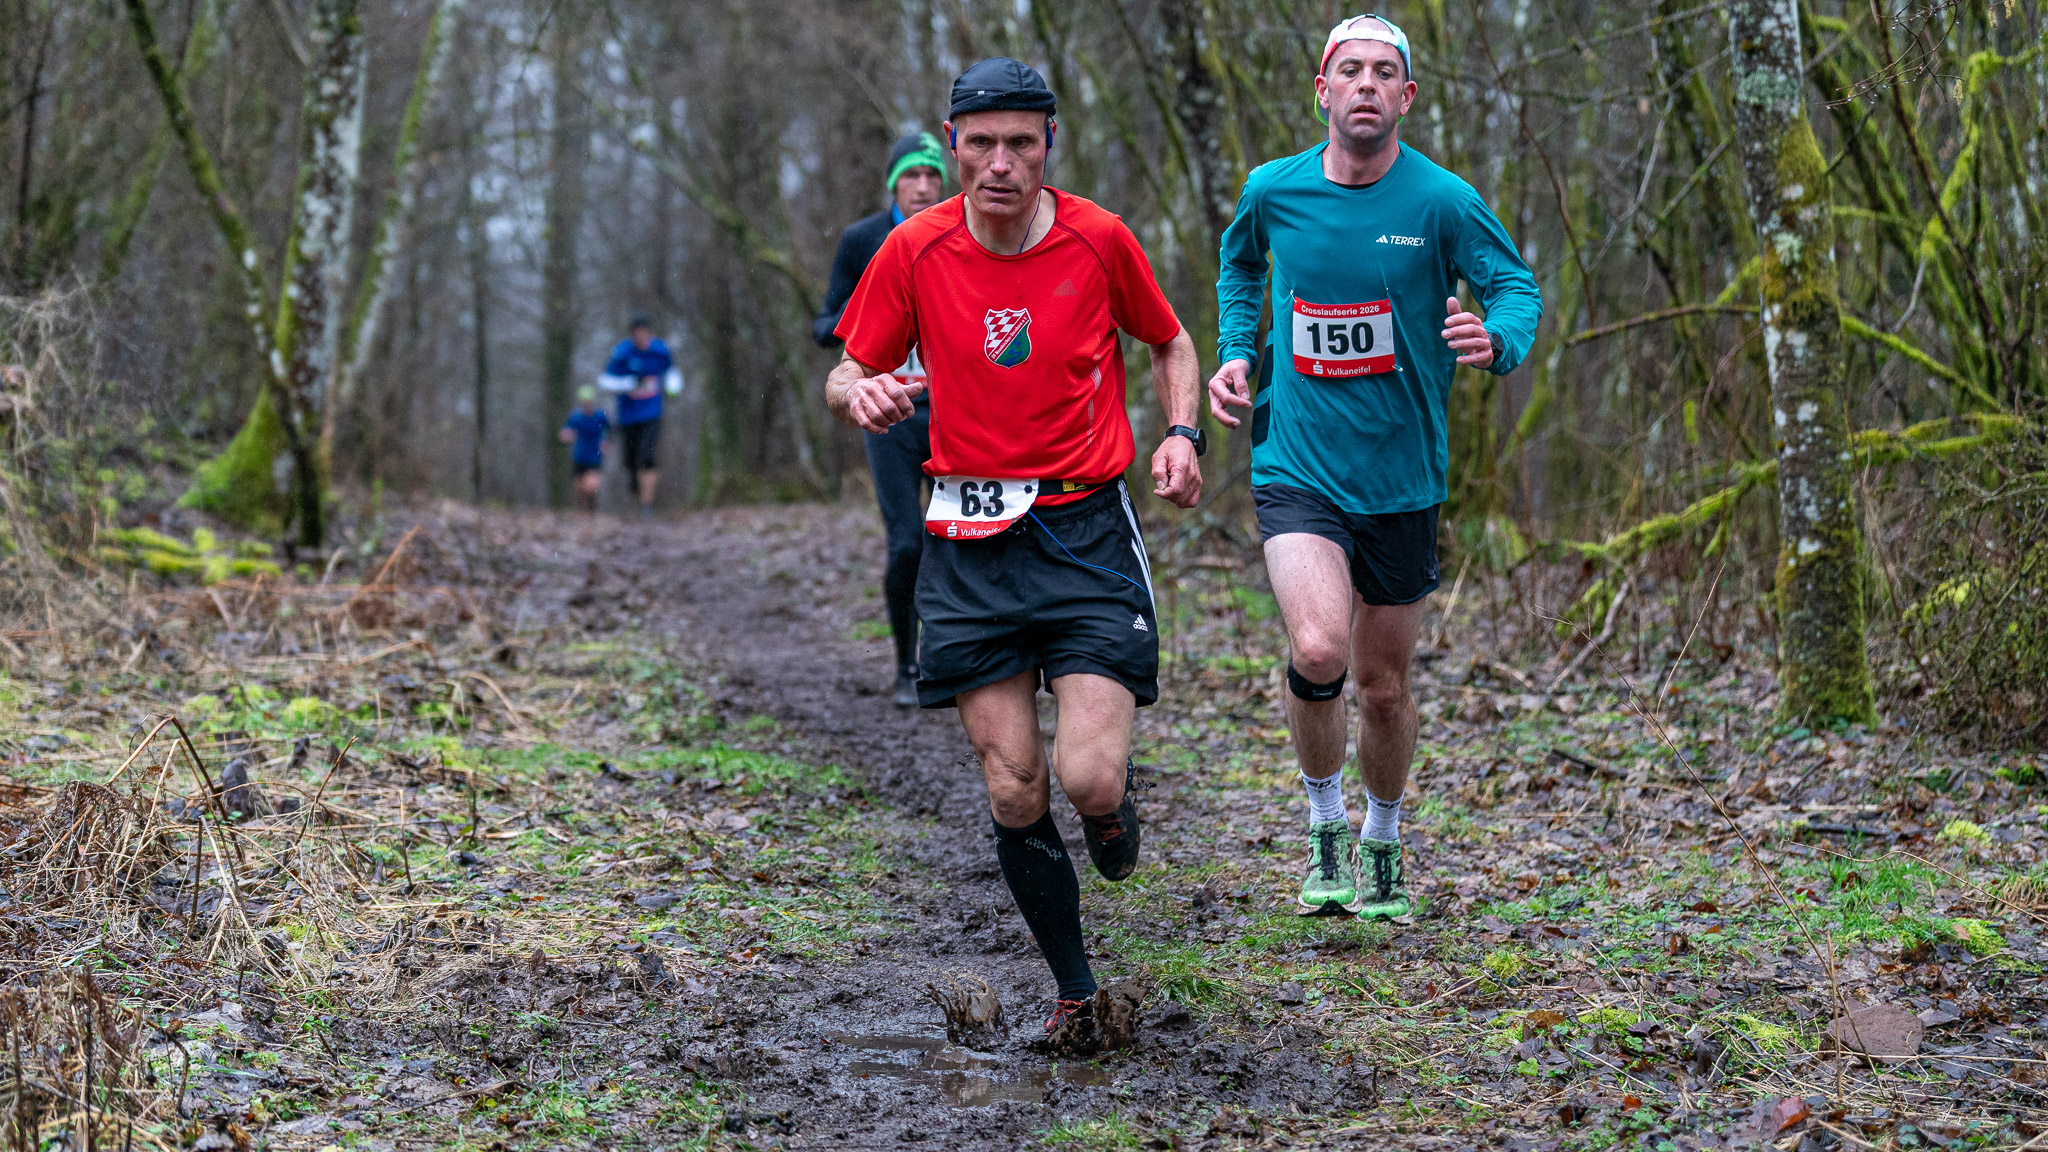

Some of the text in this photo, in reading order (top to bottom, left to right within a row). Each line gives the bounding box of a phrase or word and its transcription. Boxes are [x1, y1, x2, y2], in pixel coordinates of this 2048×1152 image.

[1390, 235, 1425, 246] TERREX
[1301, 305, 1380, 316] Crosslaufserie 2026
[1306, 322, 1374, 355] 150
[1326, 365, 1371, 376] Vulkaneifel
[959, 480, 1005, 517] 63
